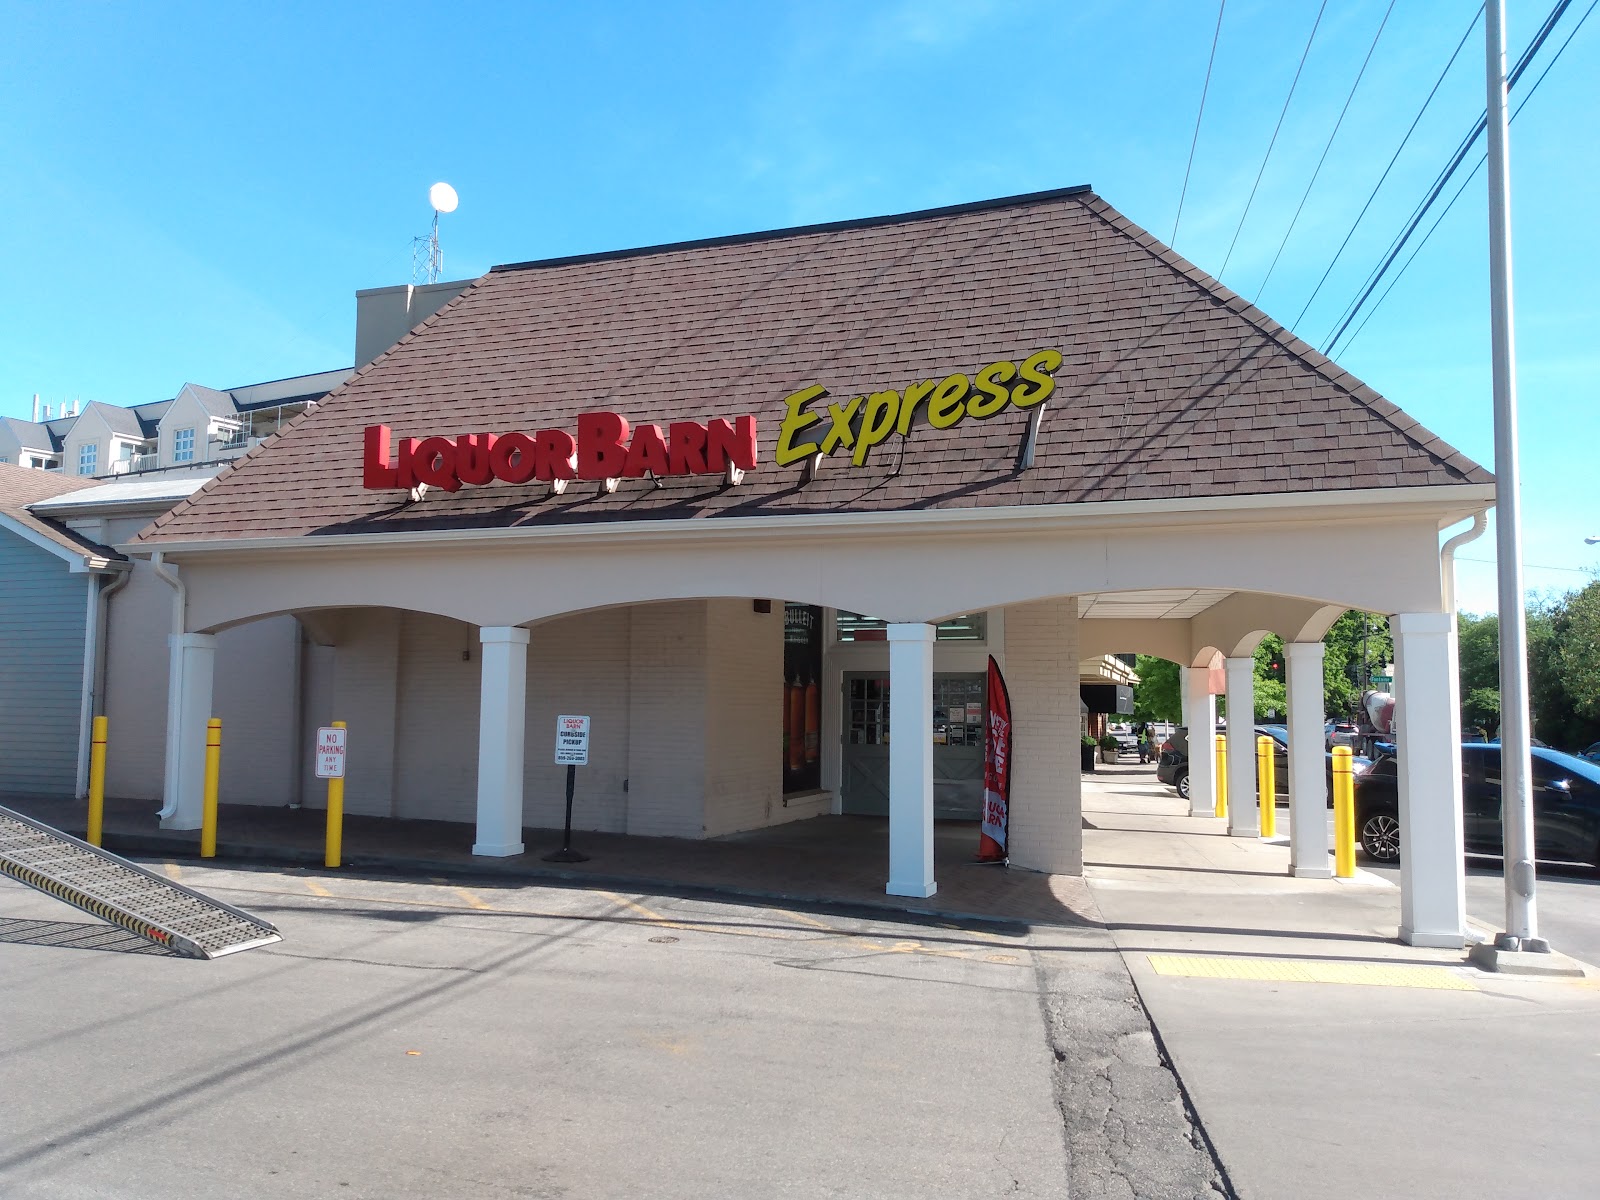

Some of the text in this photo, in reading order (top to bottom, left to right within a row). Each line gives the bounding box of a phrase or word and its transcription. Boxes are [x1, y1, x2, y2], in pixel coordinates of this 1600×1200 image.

[363, 349, 1064, 493] LIQUOR BARN Express
[326, 733, 337, 743] NO
[319, 744, 344, 755] PARKING
[324, 764, 337, 772] TIME
